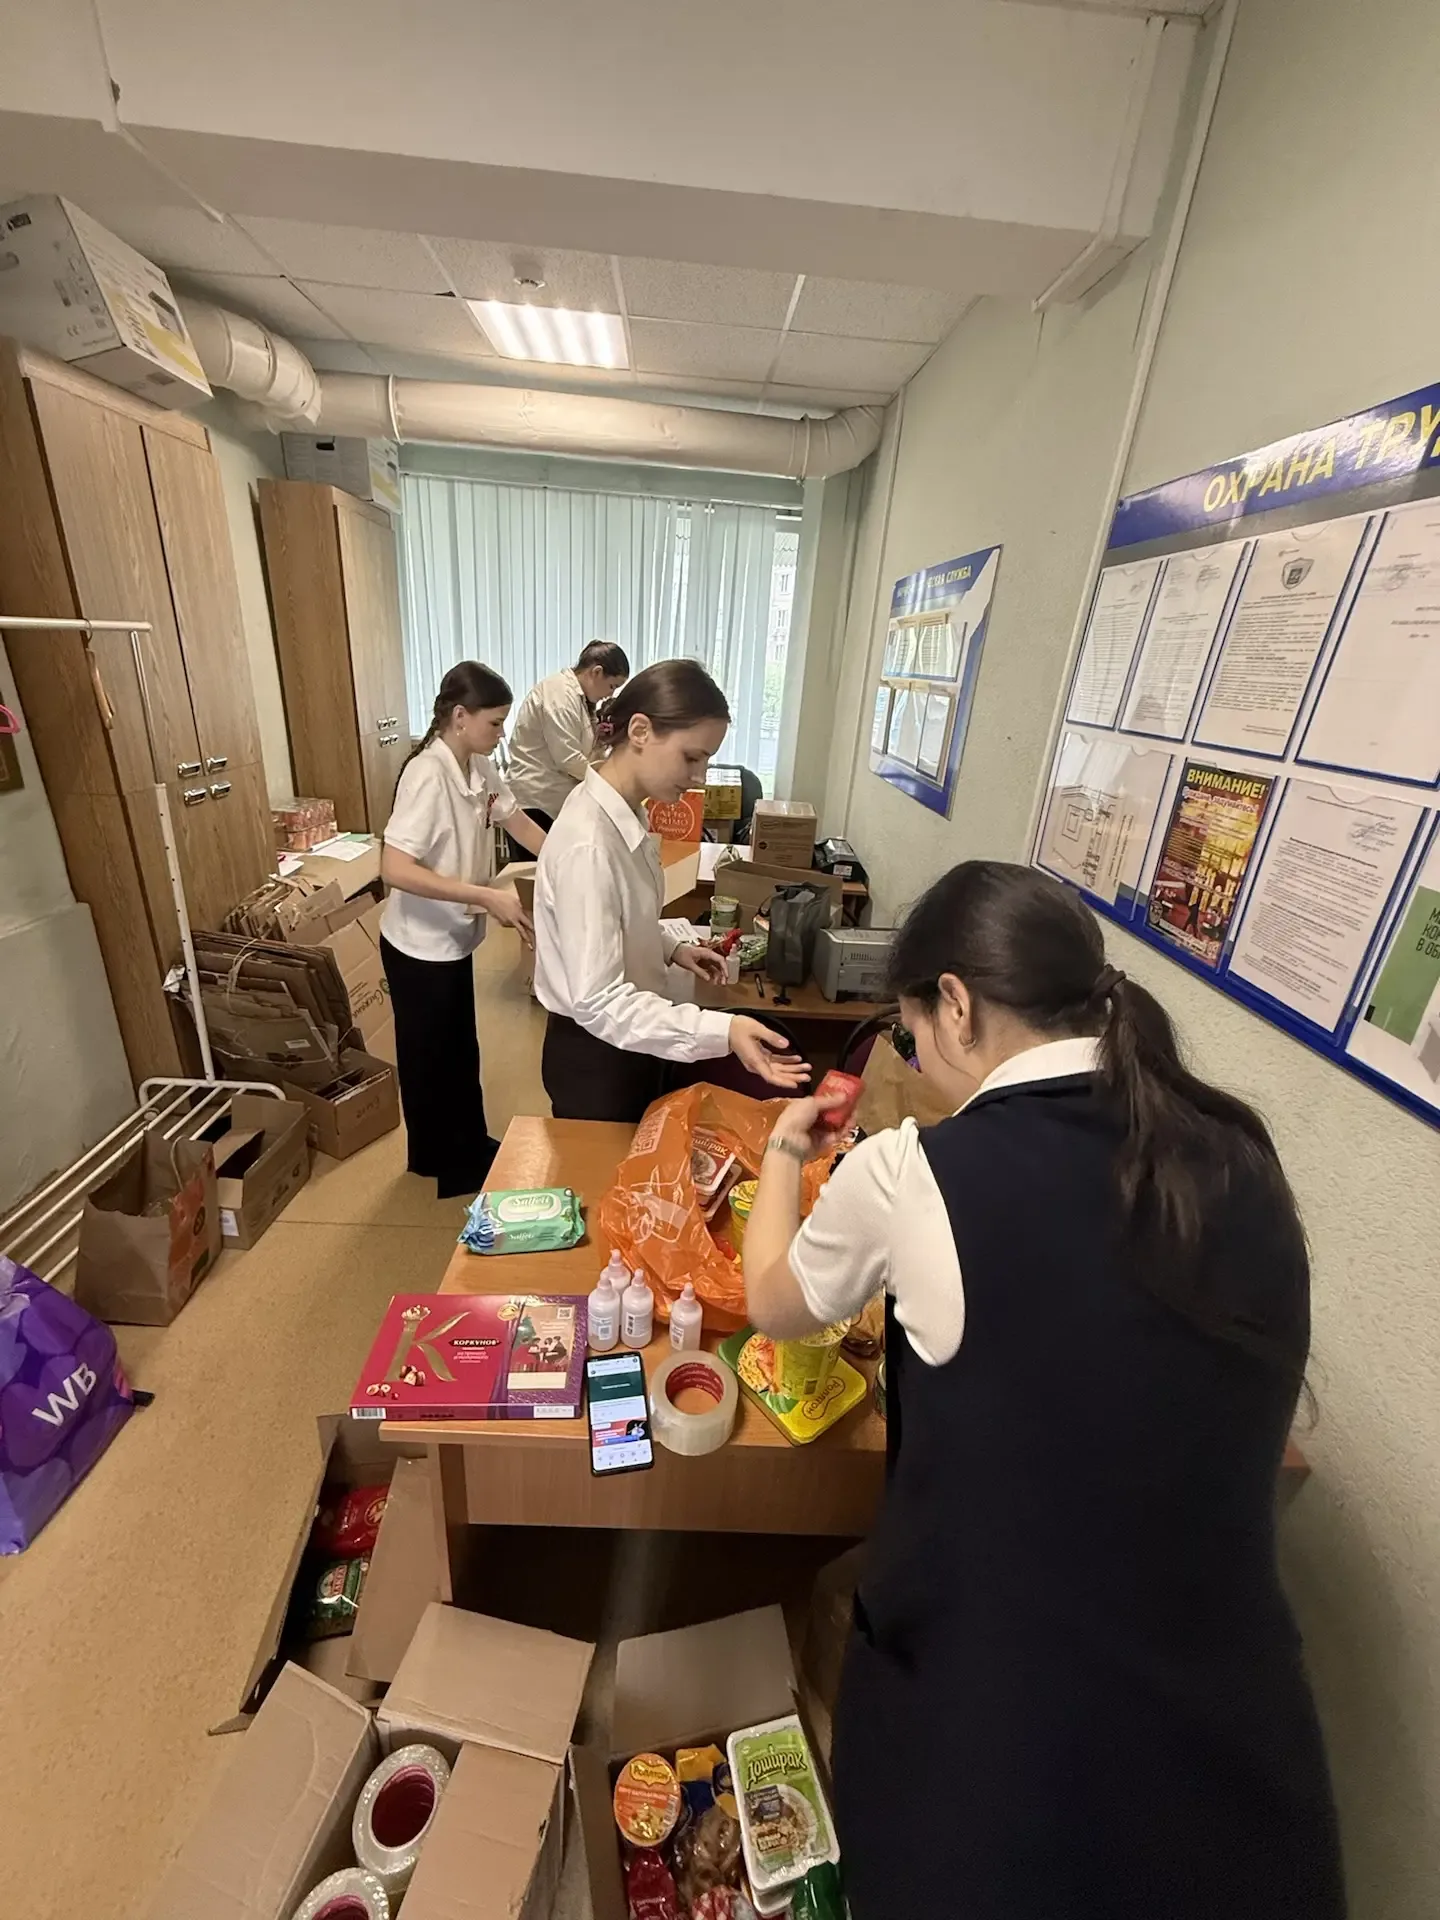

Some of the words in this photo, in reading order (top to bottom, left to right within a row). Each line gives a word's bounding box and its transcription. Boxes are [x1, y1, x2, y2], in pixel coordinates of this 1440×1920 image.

[1203, 434, 1338, 513] ОХРАНА
[1354, 404, 1440, 471] ТРУ
[1186, 768, 1267, 799] ВНИМАНИЕ!
[1415, 937, 1426, 951] В
[1425, 941, 1440, 960] ОБ
[31, 1362, 97, 1427] WB
[745, 1751, 808, 1791] Доширак
